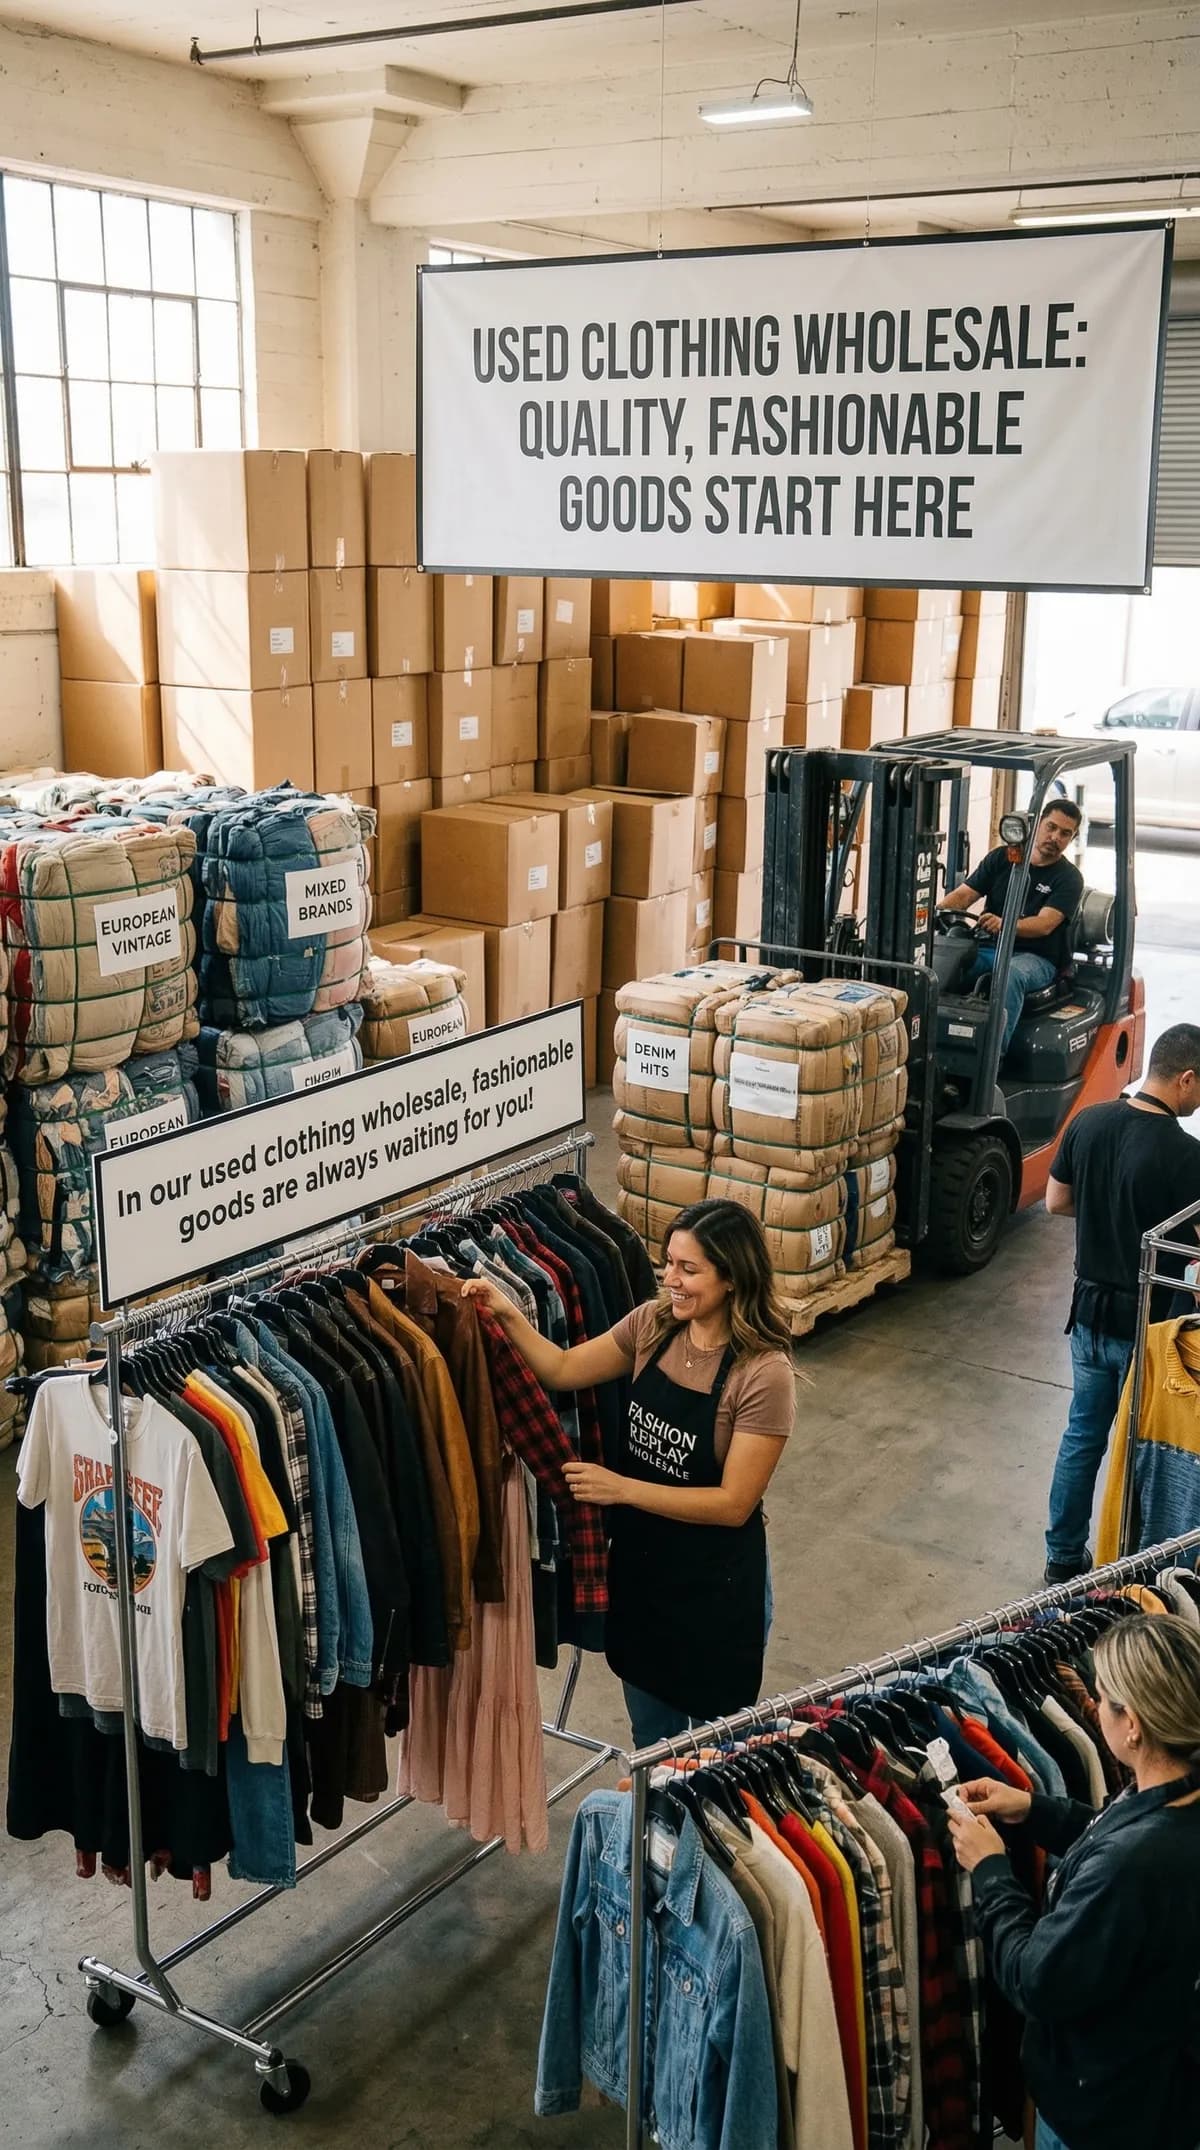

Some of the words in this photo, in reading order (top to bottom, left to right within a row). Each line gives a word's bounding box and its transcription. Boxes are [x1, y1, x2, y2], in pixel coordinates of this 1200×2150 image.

[473, 325, 569, 384] USED
[581, 314, 780, 381] CLOTHING
[793, 302, 1089, 375] WHOLESALE:
[519, 397, 693, 464] QUALITY,
[709, 390, 1025, 456] FASHIONABLE
[559, 475, 692, 534] GOODS
[704, 475, 841, 536] START
[854, 475, 975, 539] HERE
[304, 879, 347, 899] MIXED
[101, 904, 177, 936] EUROPEAN
[298, 898, 354, 921] BRANDS
[111, 929, 172, 956] VINTAGE
[412, 1016, 464, 1044] EUROPEAN
[634, 1042, 676, 1061] DENIM
[640, 1061, 670, 1078] HITS
[118, 1189, 142, 1218] In
[150, 1173, 192, 1206] our
[199, 1145, 257, 1189] used
[264, 1118, 355, 1167] clothing
[361, 1078, 467, 1133] wholesale,
[472, 1038, 574, 1094] fashionable
[179, 1191, 255, 1243] goods
[262, 1178, 298, 1208] are
[306, 1149, 378, 1192] always
[384, 1119, 459, 1163] waiting
[463, 1107, 491, 1134] for
[495, 1087, 534, 1127] you!
[628, 1400, 698, 1451] FASHION
[630, 1421, 689, 1467] REPLAY
[628, 1441, 690, 1480] WHOLESALE
